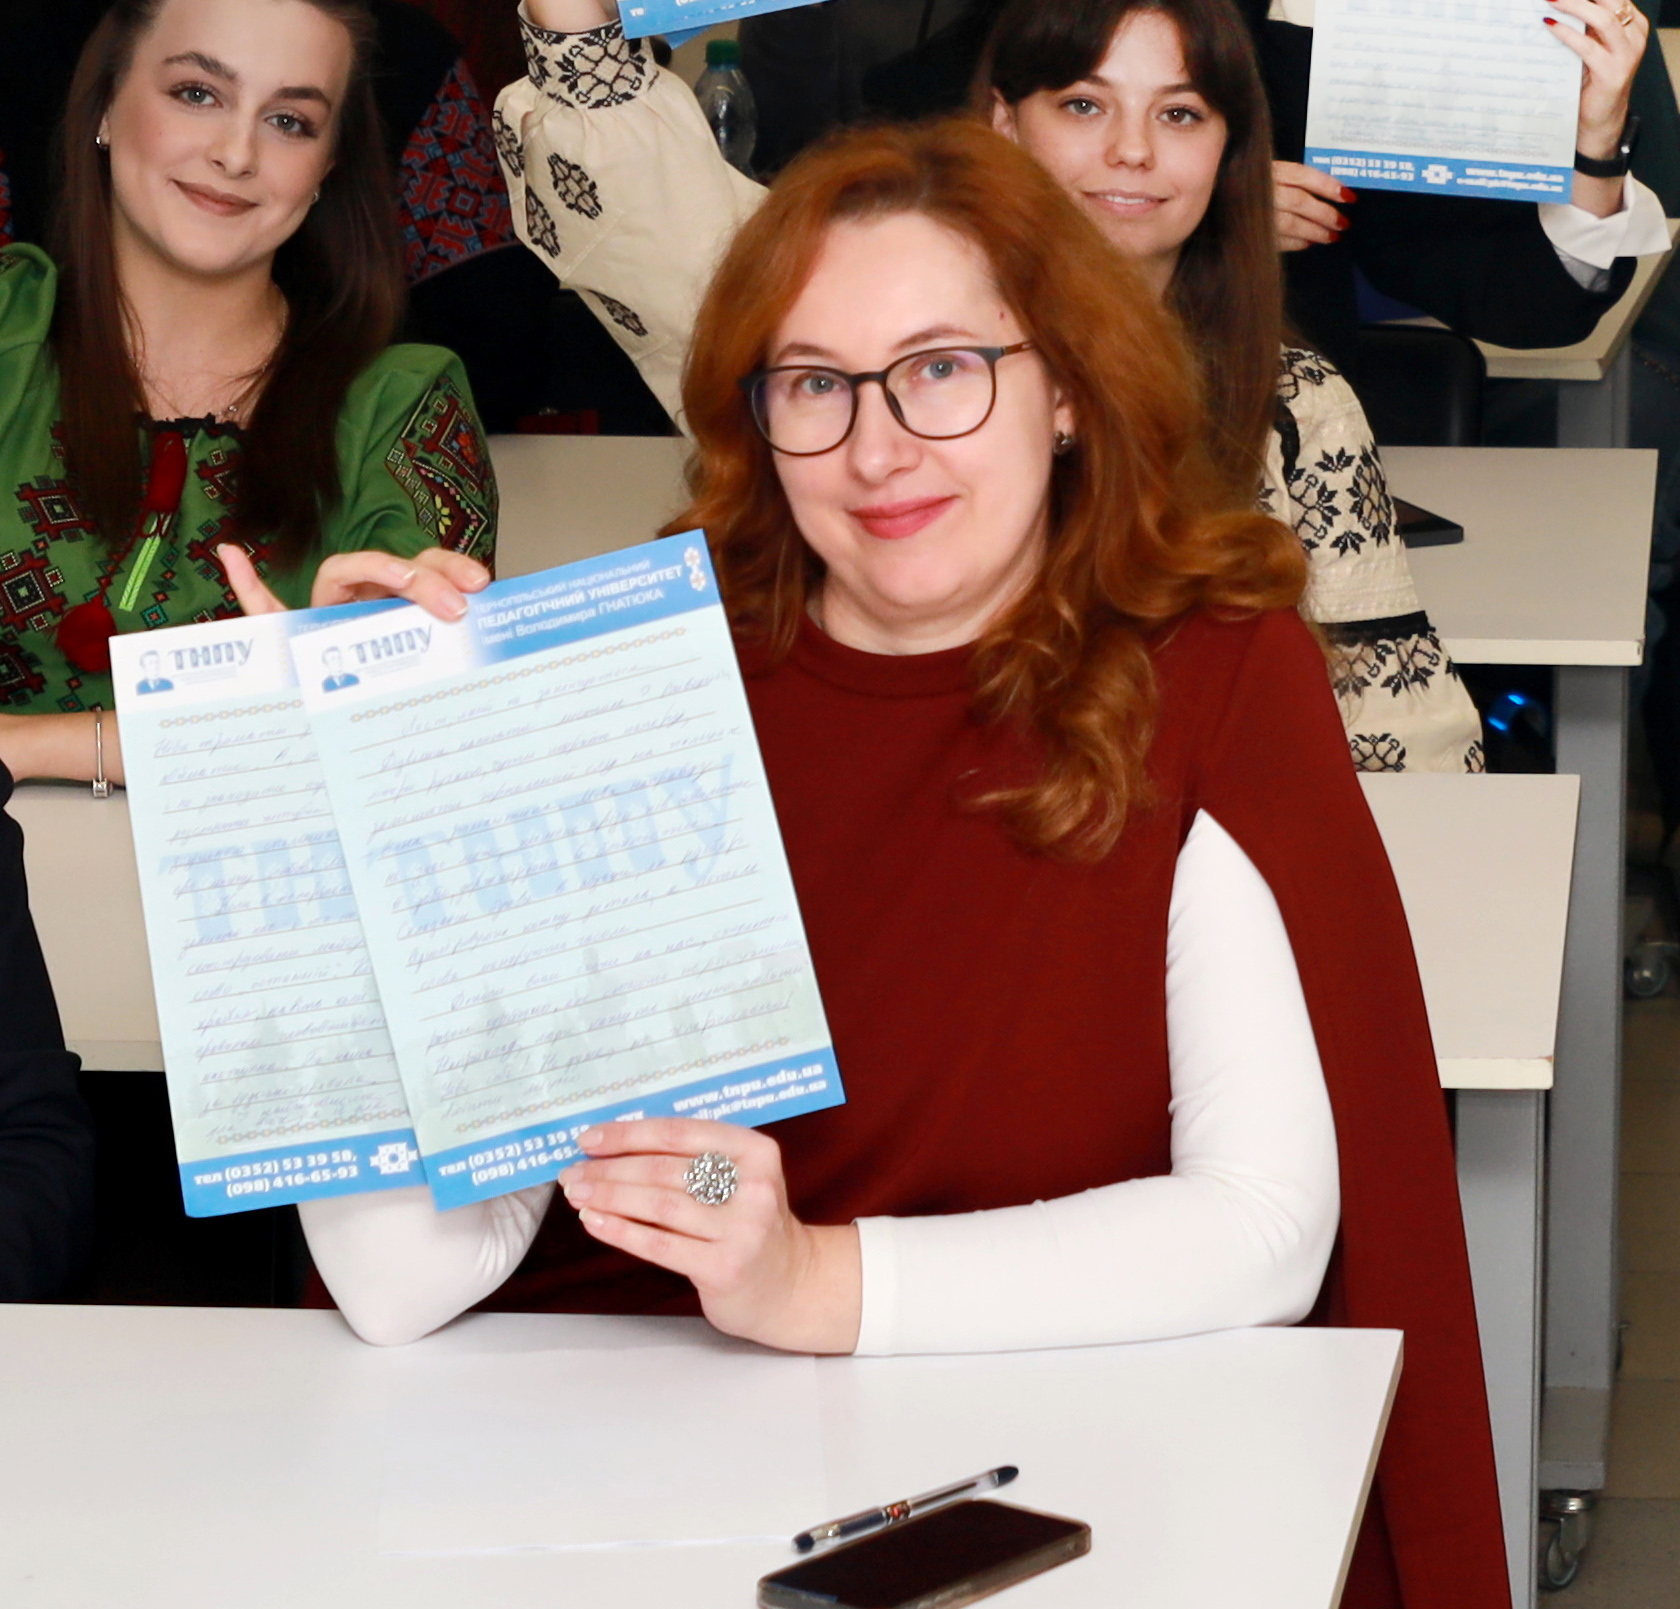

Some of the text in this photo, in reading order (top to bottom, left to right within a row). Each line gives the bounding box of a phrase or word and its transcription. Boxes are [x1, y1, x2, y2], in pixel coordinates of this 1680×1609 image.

[473, 560, 650, 613] ТЕРНОПІЛЬСЬКИЙ НАЦІОНАЛЬНИЙ
[477, 564, 683, 629] ПЕДАГОГІЧНИЙ УНІВЕРСИТЕТ
[515, 607, 596, 637] Володимира
[597, 589, 665, 618] ГНАТЮКА
[168, 637, 254, 671] ТНПУ
[350, 623, 433, 665] ТНПУ
[372, 753, 736, 937] ТНПУ
[673, 1063, 823, 1112] www.tnpu.edu.ua
[194, 1149, 357, 1187] тел (0352) 53 39 58,
[439, 1163, 465, 1179] тел
[468, 1146, 521, 1174] (0352)
[524, 1137, 544, 1152] 53
[546, 1130, 567, 1146] 39
[471, 1145, 579, 1185] (098) 416-65-
[226, 1166, 360, 1198] (098) 416-65-93
